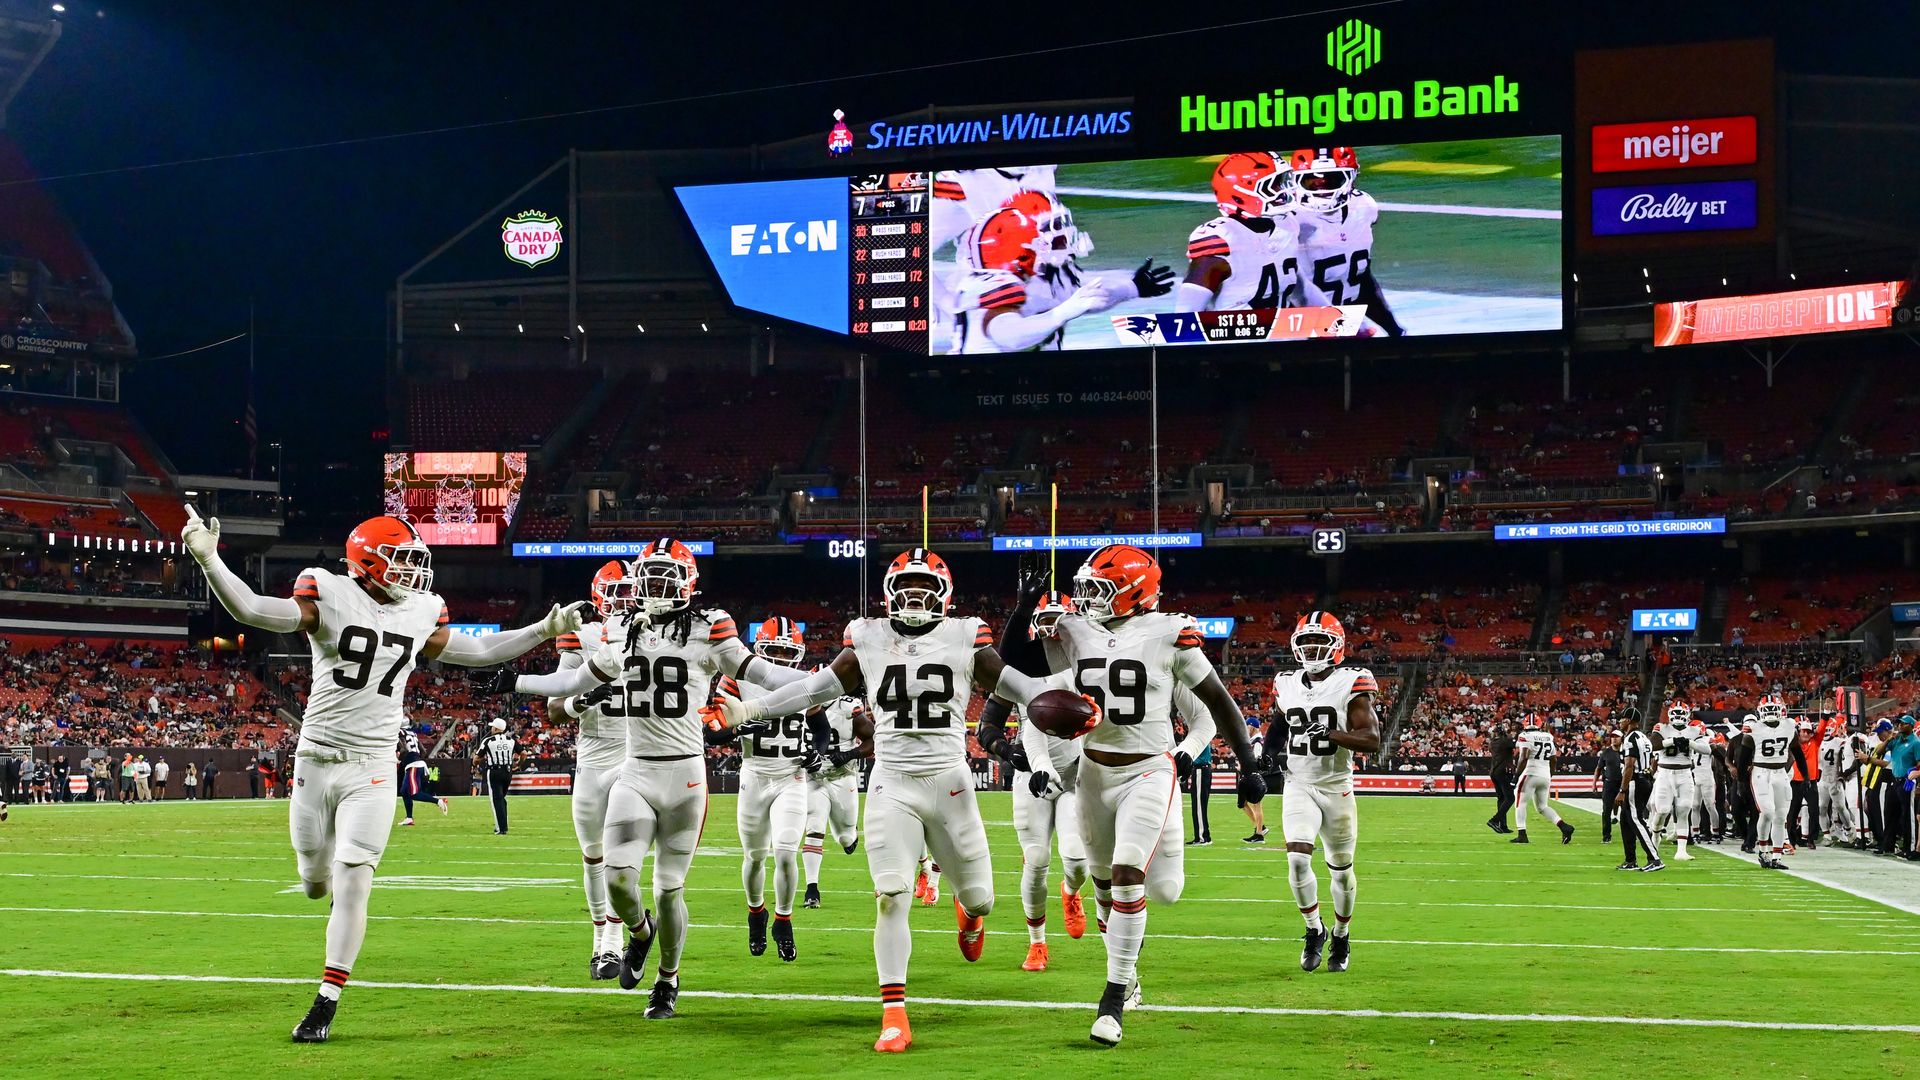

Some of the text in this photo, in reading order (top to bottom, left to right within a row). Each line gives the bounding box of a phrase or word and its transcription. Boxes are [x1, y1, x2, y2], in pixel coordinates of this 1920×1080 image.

[1181, 76, 1519, 134] Huntington Bank
[866, 111, 1131, 150] SHERWIN-WILLIAMS
[1624, 125, 1724, 163] meijer
[856, 197, 866, 216] 7
[881, 200, 895, 208] POSS
[910, 194, 923, 213] 17
[1620, 193, 1727, 223] Bally BET
[503, 230, 562, 244] CANADA
[731, 219, 837, 256] EATON
[519, 244, 547, 255] DRY
[855, 249, 867, 261] 22
[912, 246, 920, 258] 41
[856, 273, 866, 285] 77
[910, 270, 923, 282] 172
[1248, 257, 1299, 308] 42
[1217, 313, 1257, 327] 1ST & 10
[1701, 290, 1875, 334] INTERCEPTION
[853, 322, 869, 333] 4:22
[908, 319, 927, 331] 10:20
[1173, 318, 1184, 337] 7
[1235, 327, 1251, 337] 0:06
[1255, 326, 1265, 336] 25
[1288, 313, 1303, 332] 17
[17, 335, 88, 350] CROSSCOUNTRY
[17, 345, 55, 354] MORTGAGE
[977, 390, 1153, 406] TEXT ISSUES TO 440-824-6000
[1550, 525, 1578, 535] FROM
[1580, 525, 1599, 534] THE
[1600, 524, 1625, 534] GRID
[1627, 523, 1640, 533] TO
[1641, 523, 1661, 533] THE
[1662, 521, 1712, 532] GRIDIRON
[73, 534, 186, 555] INTERCEPTI
[561, 545, 587, 554] FROM
[588, 545, 605, 554] THE
[606, 544, 628, 554] GRID
[629, 544, 642, 554] TO
[829, 540, 865, 557] 0:06
[1043, 538, 1069, 547] FROM
[1071, 538, 1088, 547] THE
[1090, 537, 1112, 546] GRID
[1113, 537, 1126, 546] TO
[1127, 536, 1145, 545] THE
[1146, 535, 1190, 545] GRIDIRON
[1317, 531, 1342, 550] 25
[1198, 621, 1227, 634] TON
[1641, 613, 1689, 627] EATON
[333, 625, 414, 697] 97
[622, 655, 689, 718] 28
[877, 663, 954, 729] 42
[1075, 657, 1147, 725] 59
[1850, 691, 1857, 715] 1
[752, 713, 804, 758] 29
[1534, 741, 1552, 761] 72
[1761, 737, 1789, 757] 67
